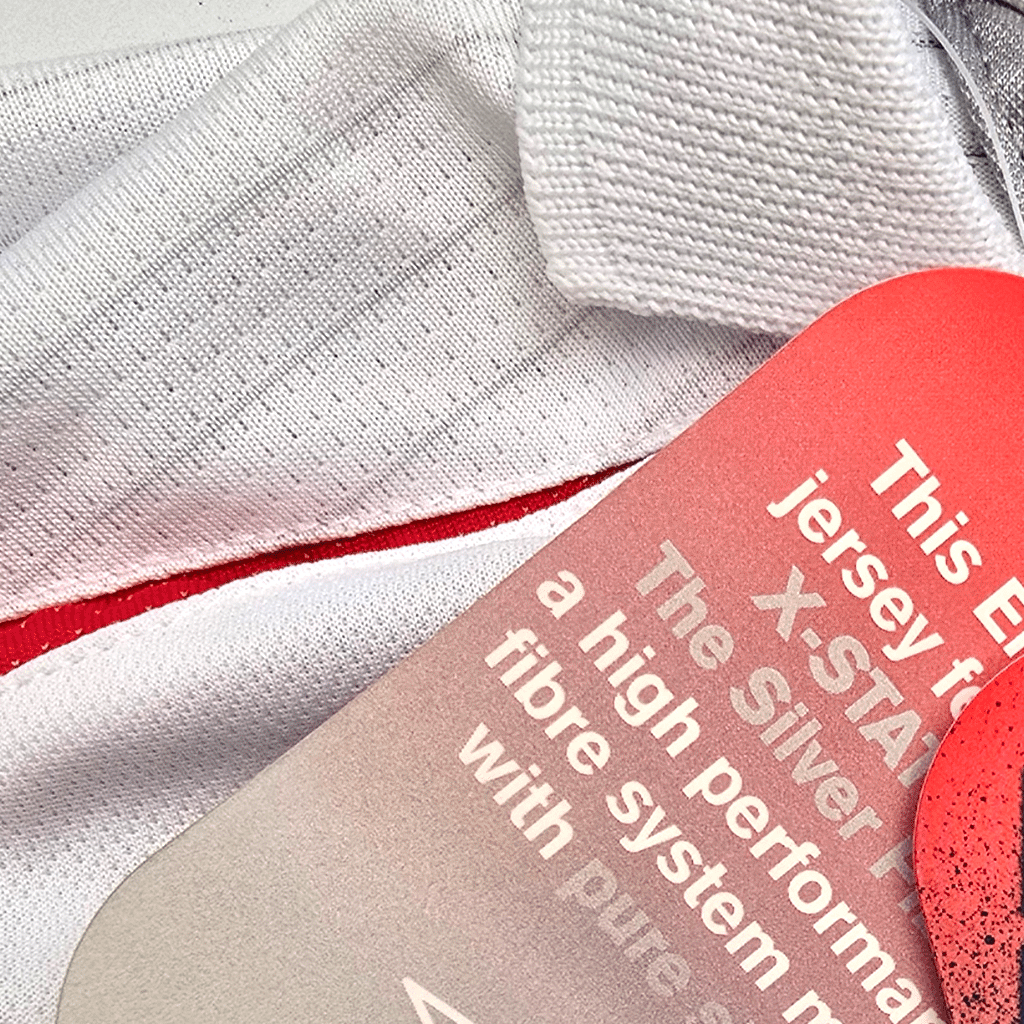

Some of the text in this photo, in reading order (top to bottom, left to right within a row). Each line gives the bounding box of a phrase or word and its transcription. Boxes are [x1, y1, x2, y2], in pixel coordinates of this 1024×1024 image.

[766, 469, 944, 662] jersey
[870, 439, 982, 585] This
[536, 570, 586, 620] a
[577, 610, 702, 758] high
[634, 539, 883, 840] The Silver
[751, 565, 940, 788] X-STAT
[457, 722, 575, 860] with
[555, 858, 693, 997] pure
[484, 628, 611, 776] fibre
[605, 780, 791, 991] system
